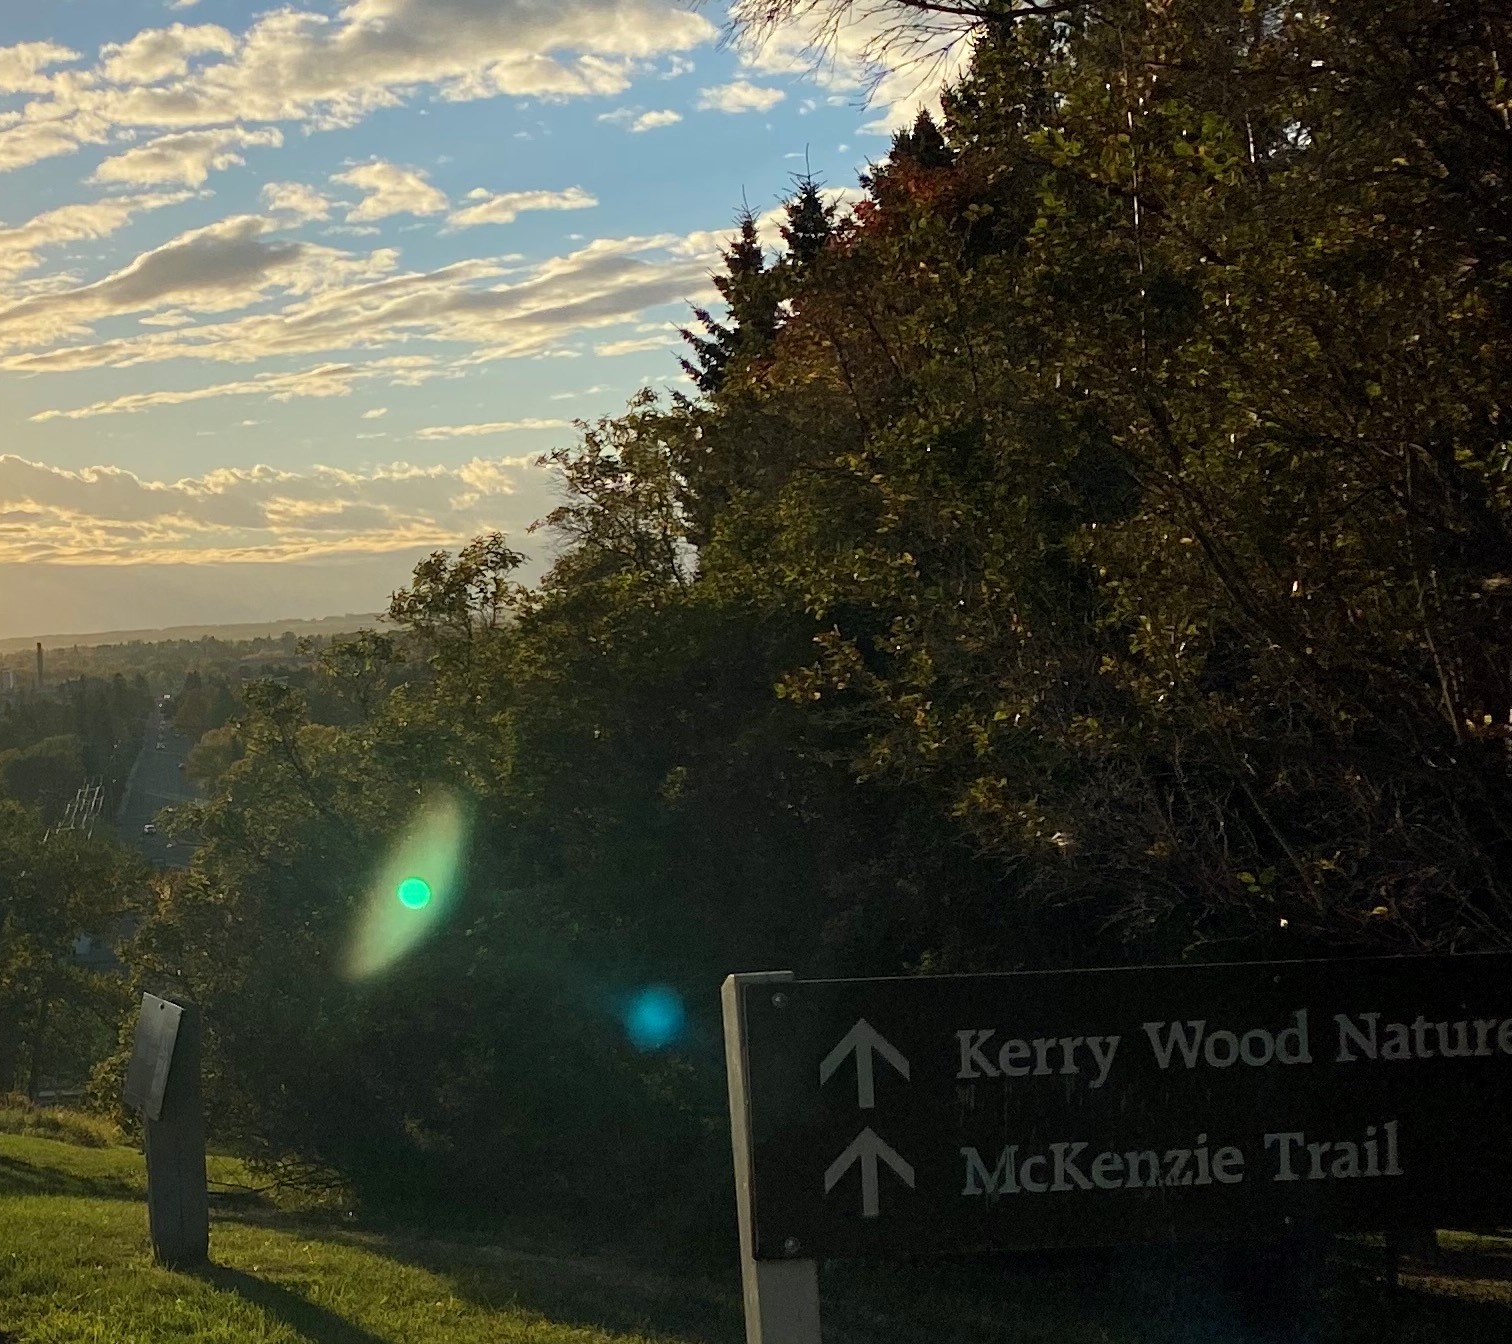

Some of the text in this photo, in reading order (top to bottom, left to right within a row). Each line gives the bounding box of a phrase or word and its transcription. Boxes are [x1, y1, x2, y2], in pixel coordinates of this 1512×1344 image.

[955, 1028, 1120, 1089] Kerry
[1143, 1009, 1312, 1069] Wood
[960, 1121, 1404, 1197] McKenzie Trail
